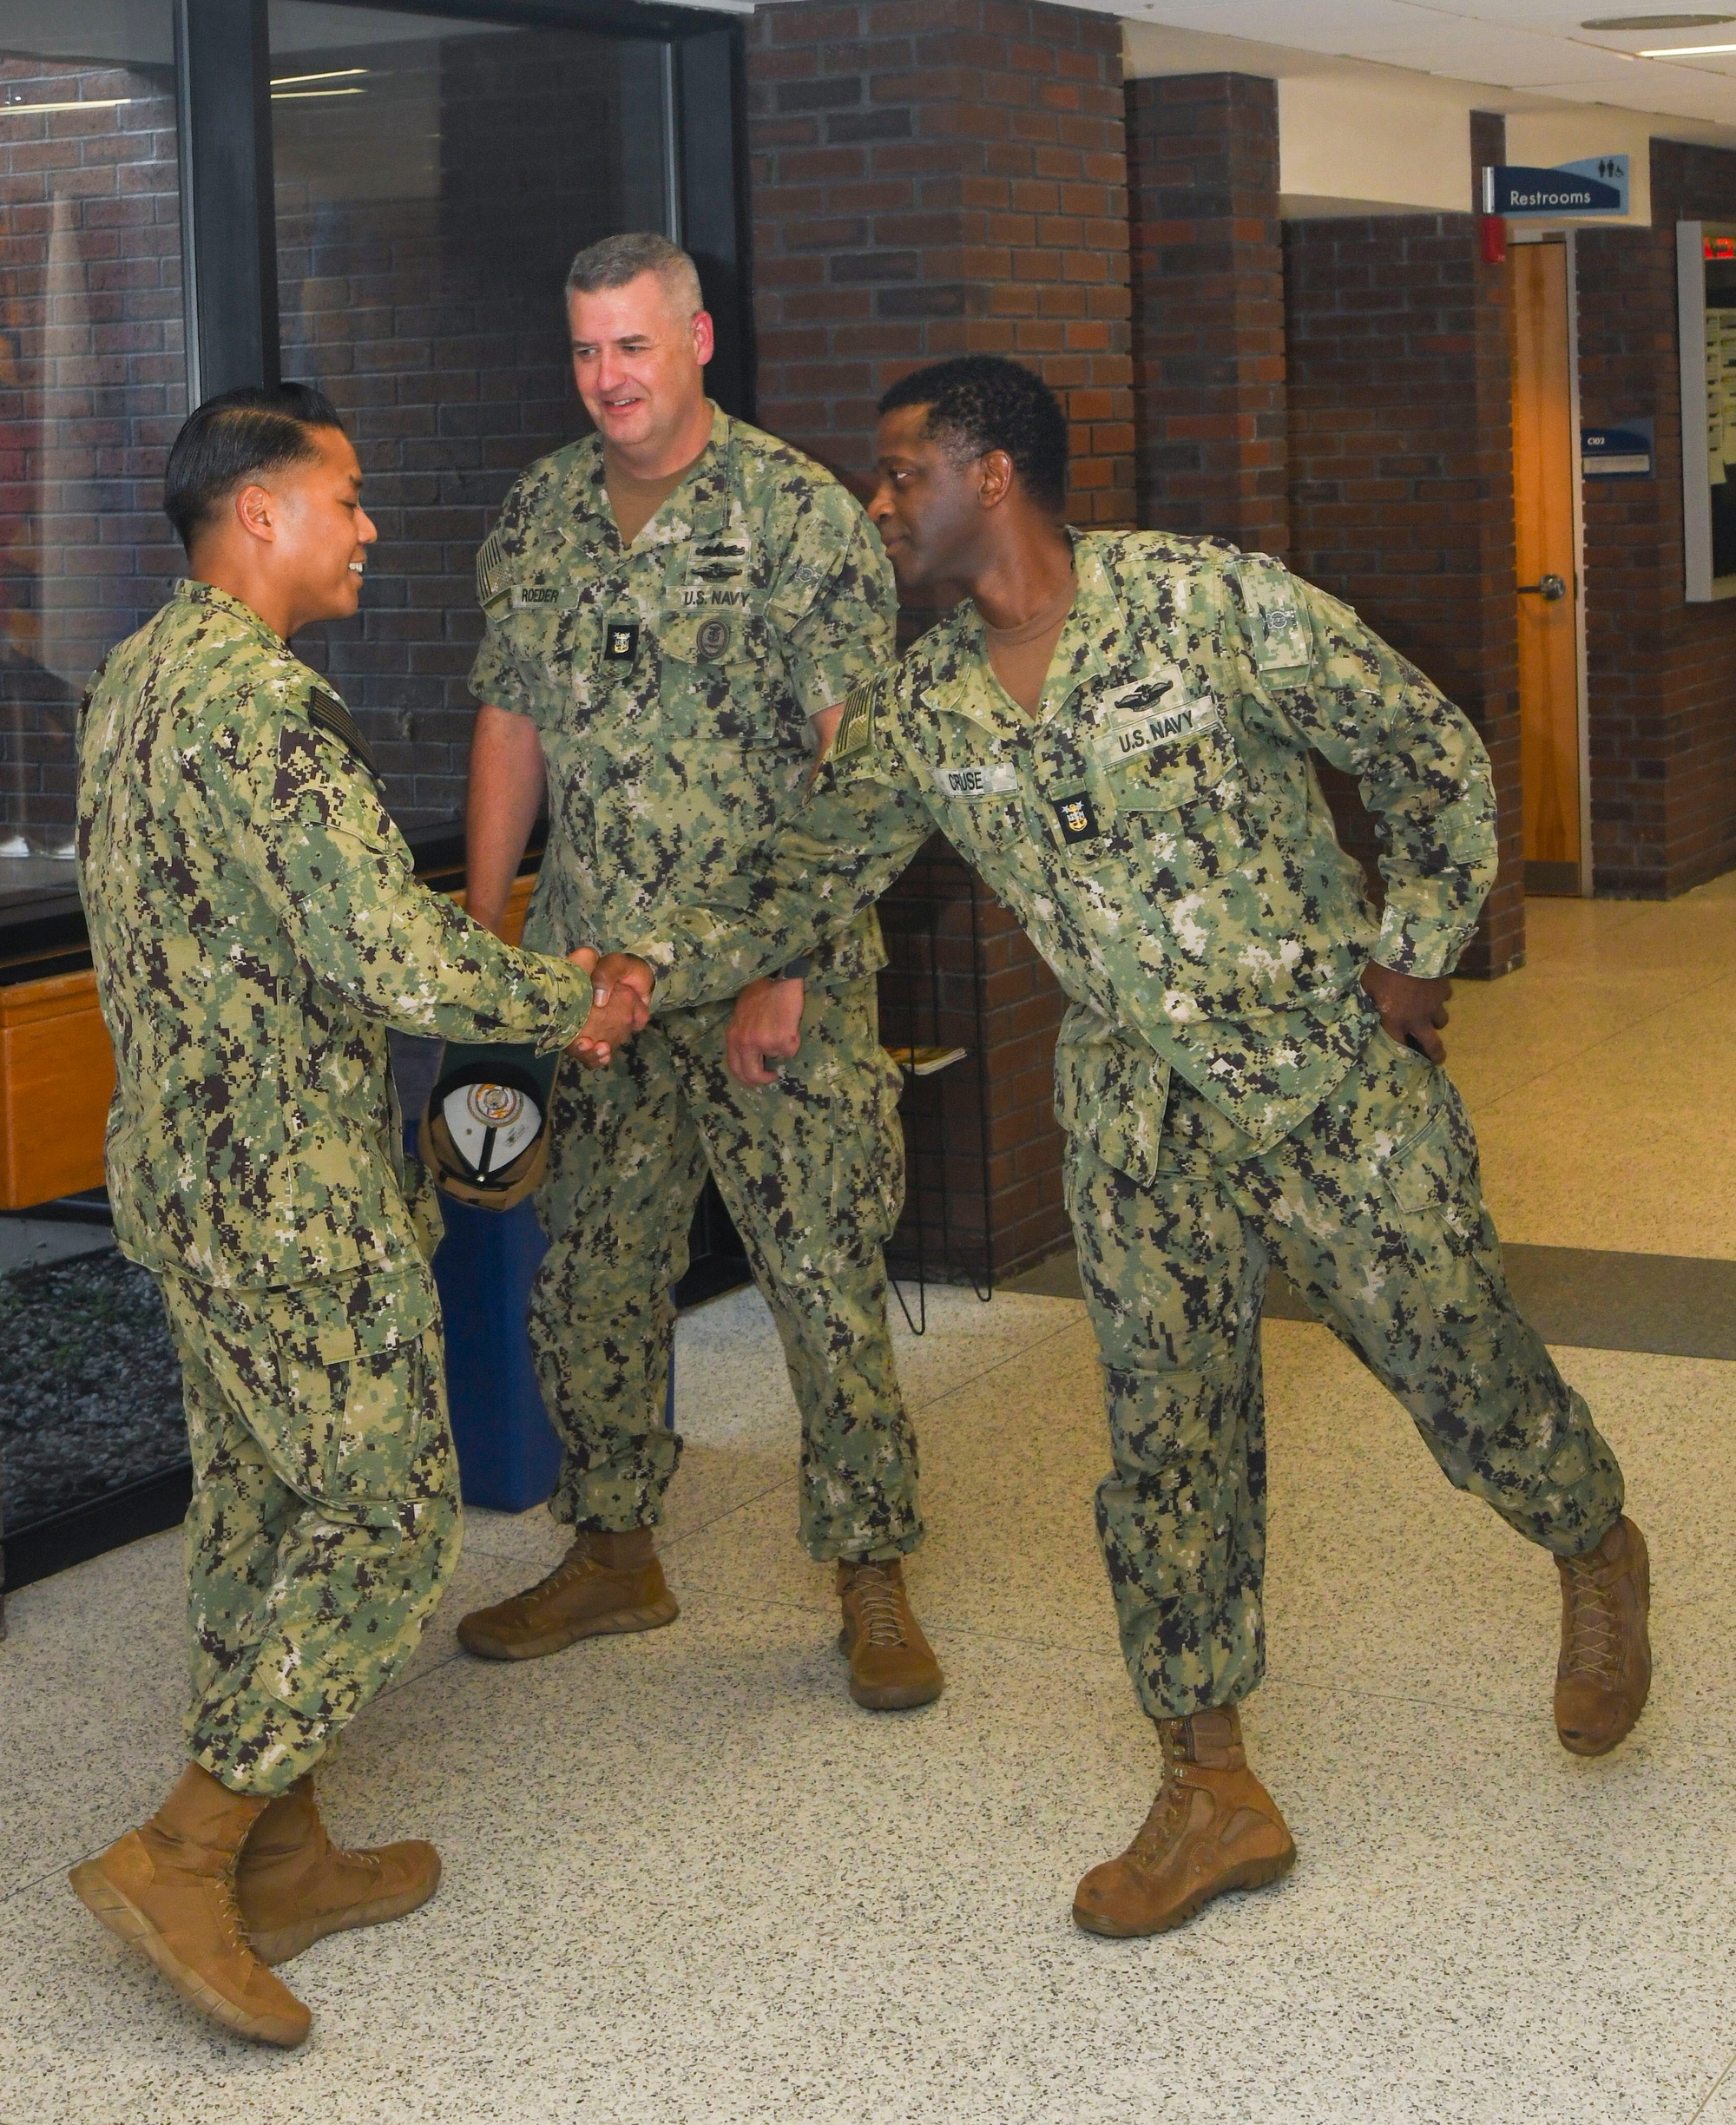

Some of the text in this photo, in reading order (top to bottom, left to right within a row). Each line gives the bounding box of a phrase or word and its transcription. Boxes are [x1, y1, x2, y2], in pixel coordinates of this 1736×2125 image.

[1510, 190, 1591, 206] Restrooms
[1587, 437, 1605, 445] C102
[522, 588, 559, 603] ROEDER
[683, 590, 750, 608] U.S. NAVY
[1118, 710, 1194, 753] U.S. NAVY
[948, 771, 983, 791] CRUSE
